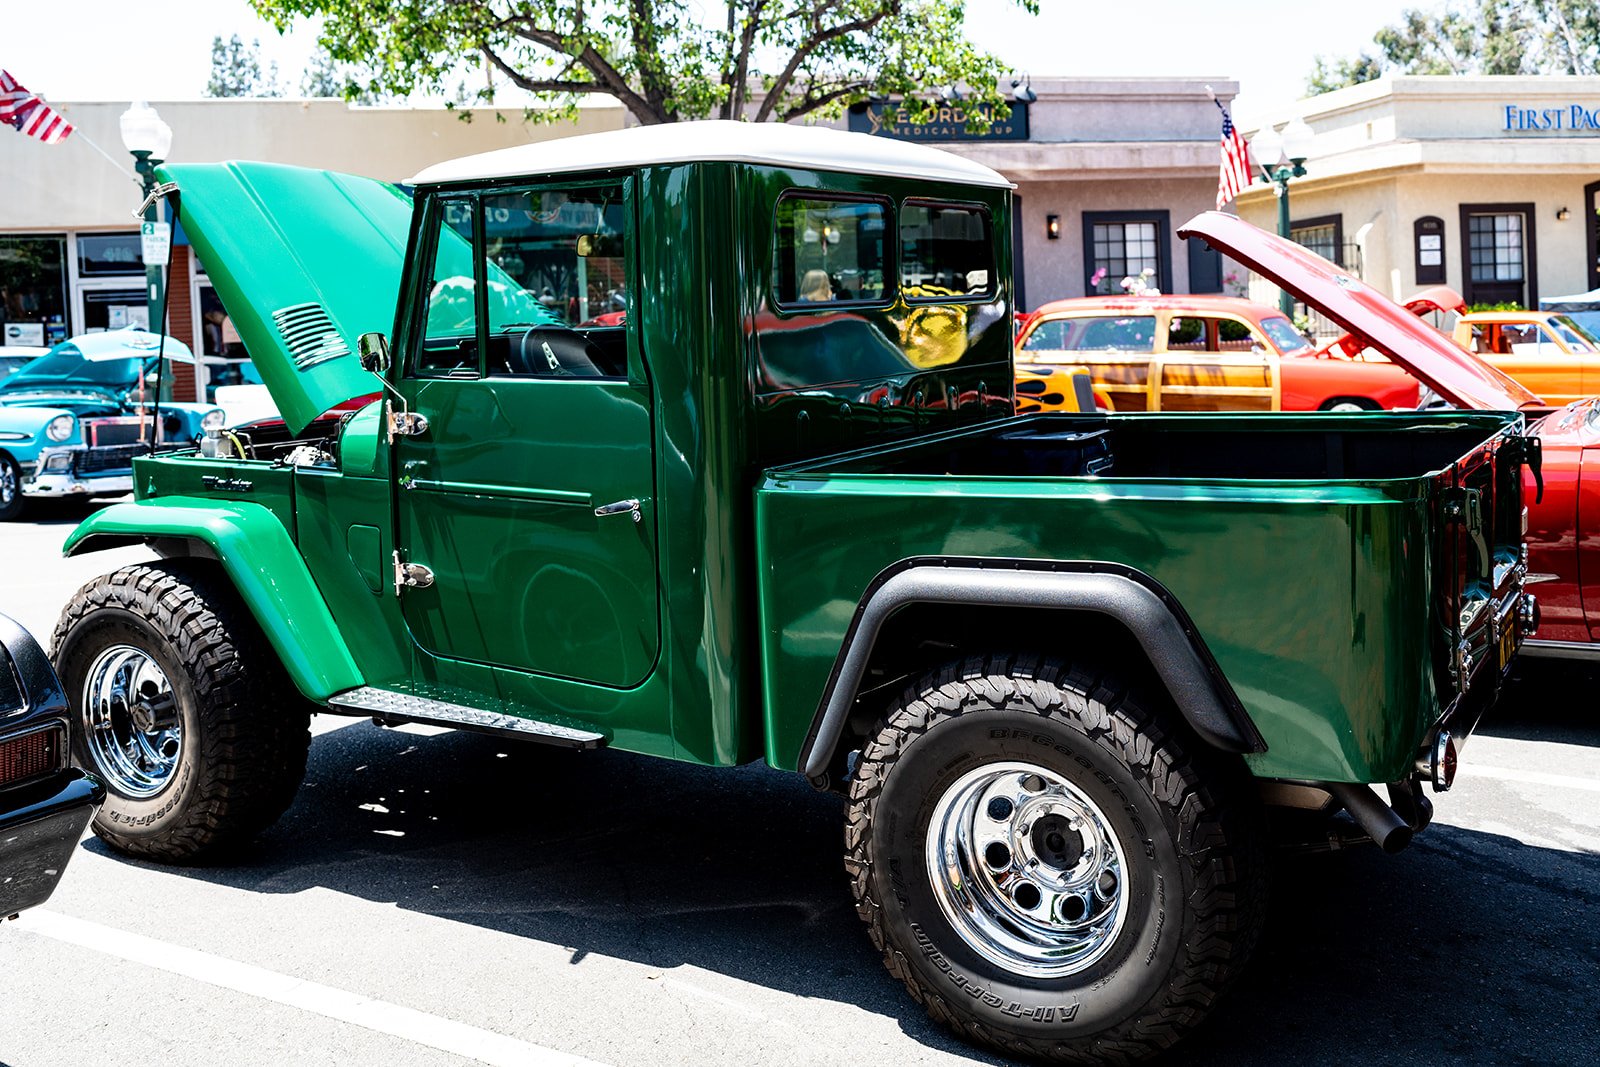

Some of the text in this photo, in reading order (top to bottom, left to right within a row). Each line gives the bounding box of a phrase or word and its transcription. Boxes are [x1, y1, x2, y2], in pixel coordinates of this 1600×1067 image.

[1504, 105, 1565, 129] FIRST
[144, 223, 152, 234] 2
[910, 922, 1080, 1023] All-Terrain
